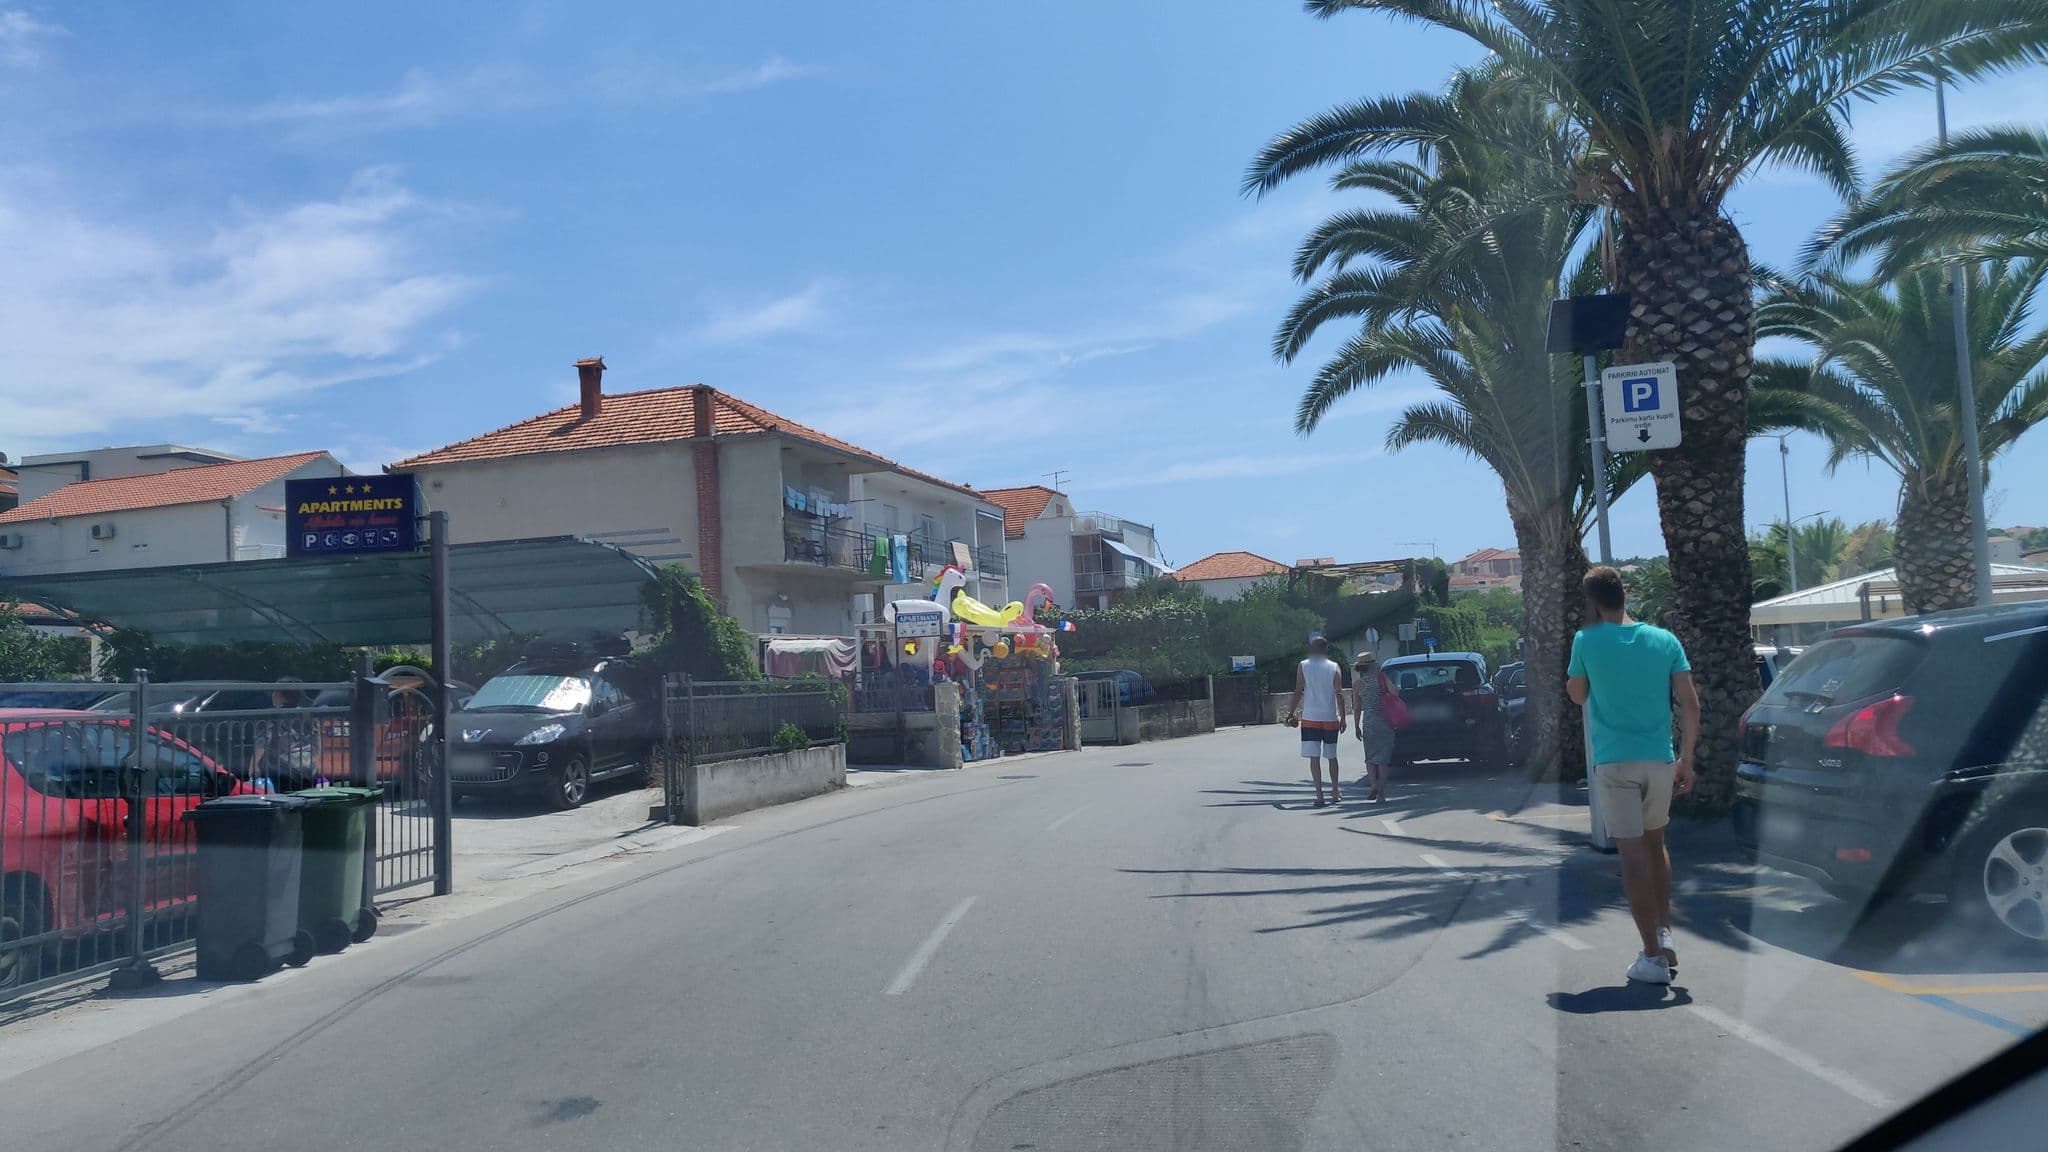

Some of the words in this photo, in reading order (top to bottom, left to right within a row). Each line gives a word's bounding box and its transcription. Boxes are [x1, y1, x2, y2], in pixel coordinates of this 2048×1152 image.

[1608, 370, 1638, 380] PARKIRNI
[1639, 367, 1669, 376] AUTOMAT
[1631, 383, 1652, 409] P
[298, 498, 403, 513] APARTMENTS
[306, 534, 316, 548] P
